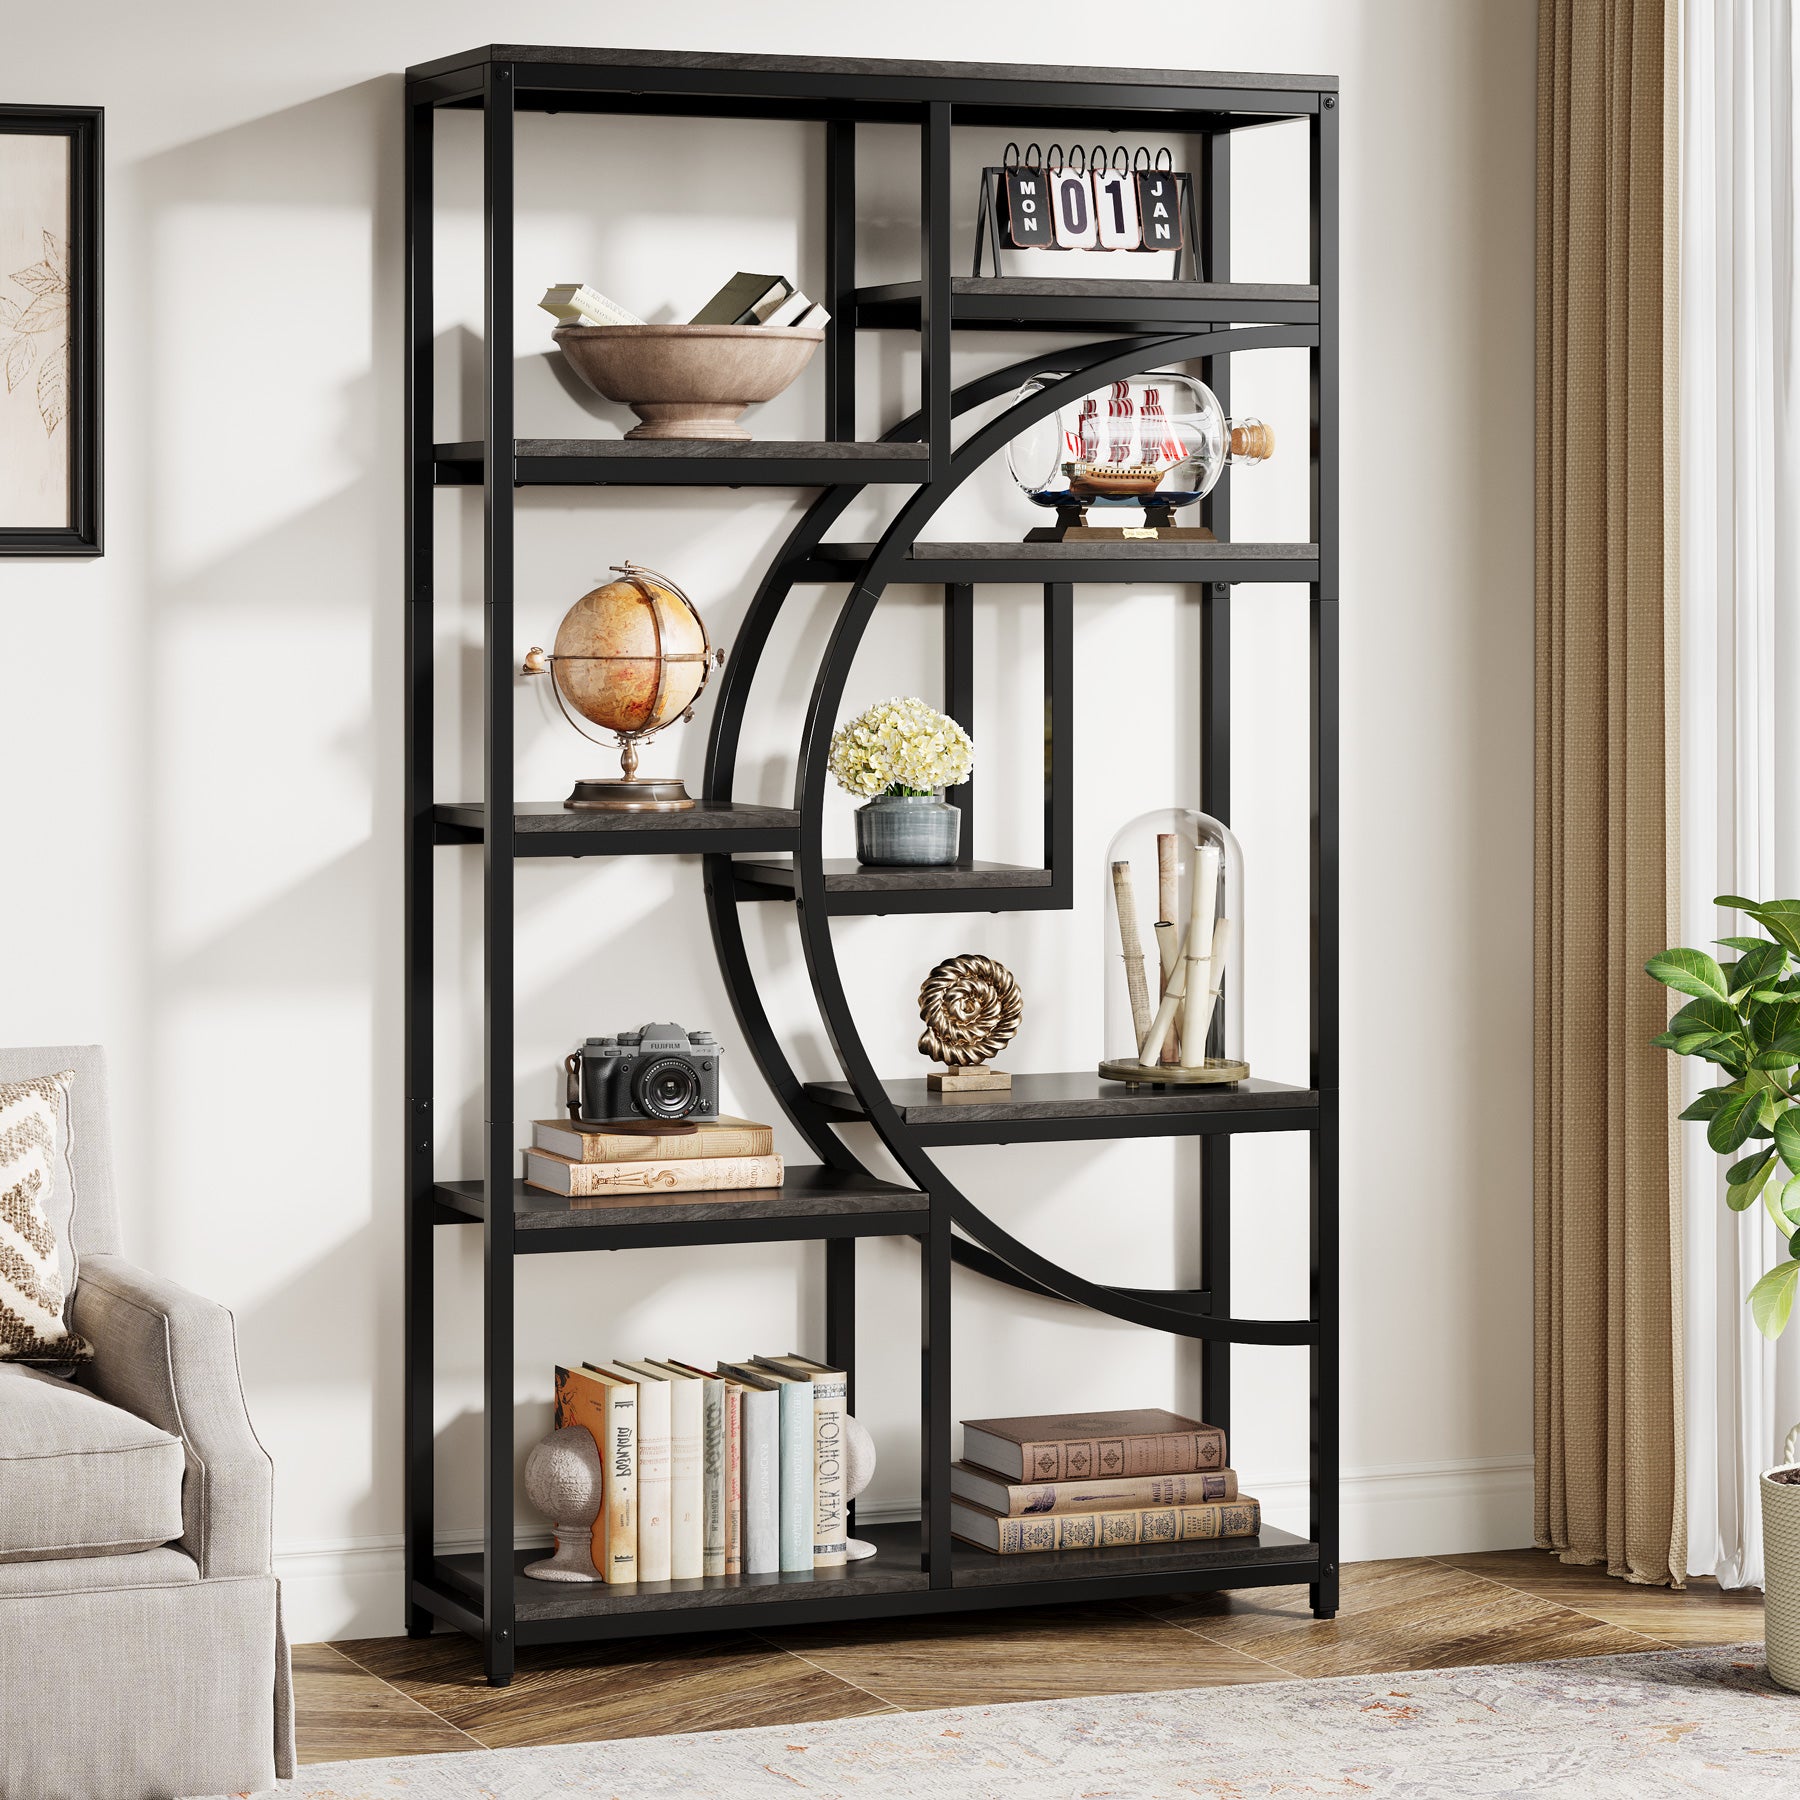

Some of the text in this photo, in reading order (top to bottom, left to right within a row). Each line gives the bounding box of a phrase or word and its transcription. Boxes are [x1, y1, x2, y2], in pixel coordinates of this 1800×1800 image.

[1019, 181, 1038, 231] MON
[1060, 178, 1126, 234] 01
[1150, 181, 1171, 240] JAN
